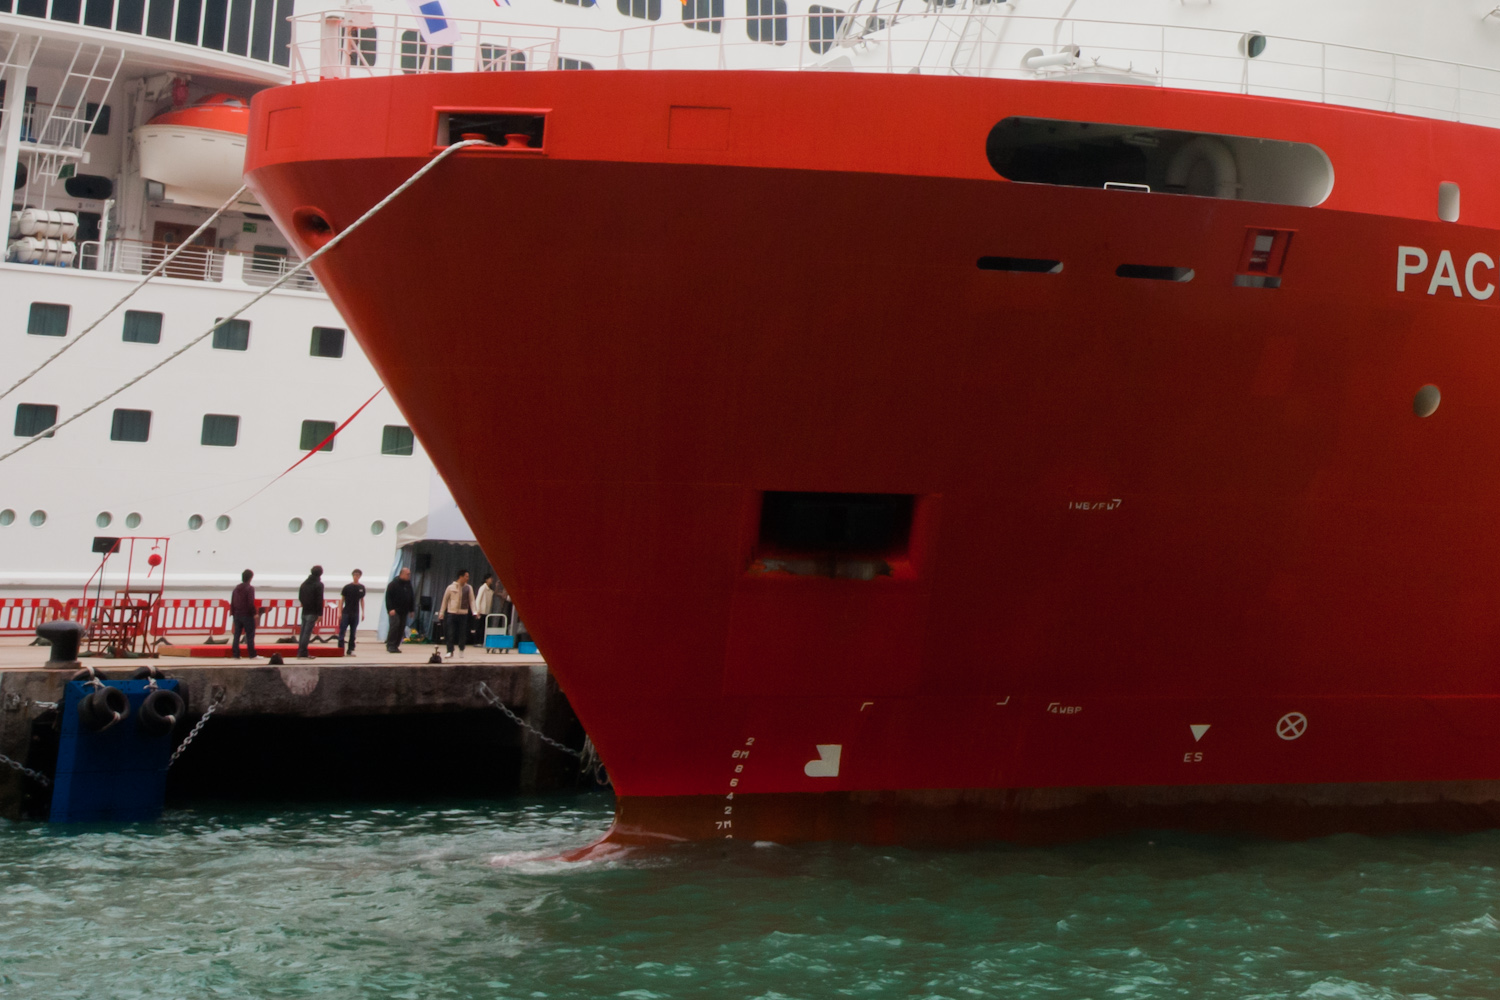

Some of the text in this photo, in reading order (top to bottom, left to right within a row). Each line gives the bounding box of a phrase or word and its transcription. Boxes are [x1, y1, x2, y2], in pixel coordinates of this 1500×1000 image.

[745, 737, 755, 746] 2
[1183, 752, 1204, 763] ES
[734, 764, 744, 773] 8
[729, 778, 739, 787] 6
[726, 792, 734, 800] 4
[724, 806, 733, 815] 2
[715, 820, 732, 830] 7M
